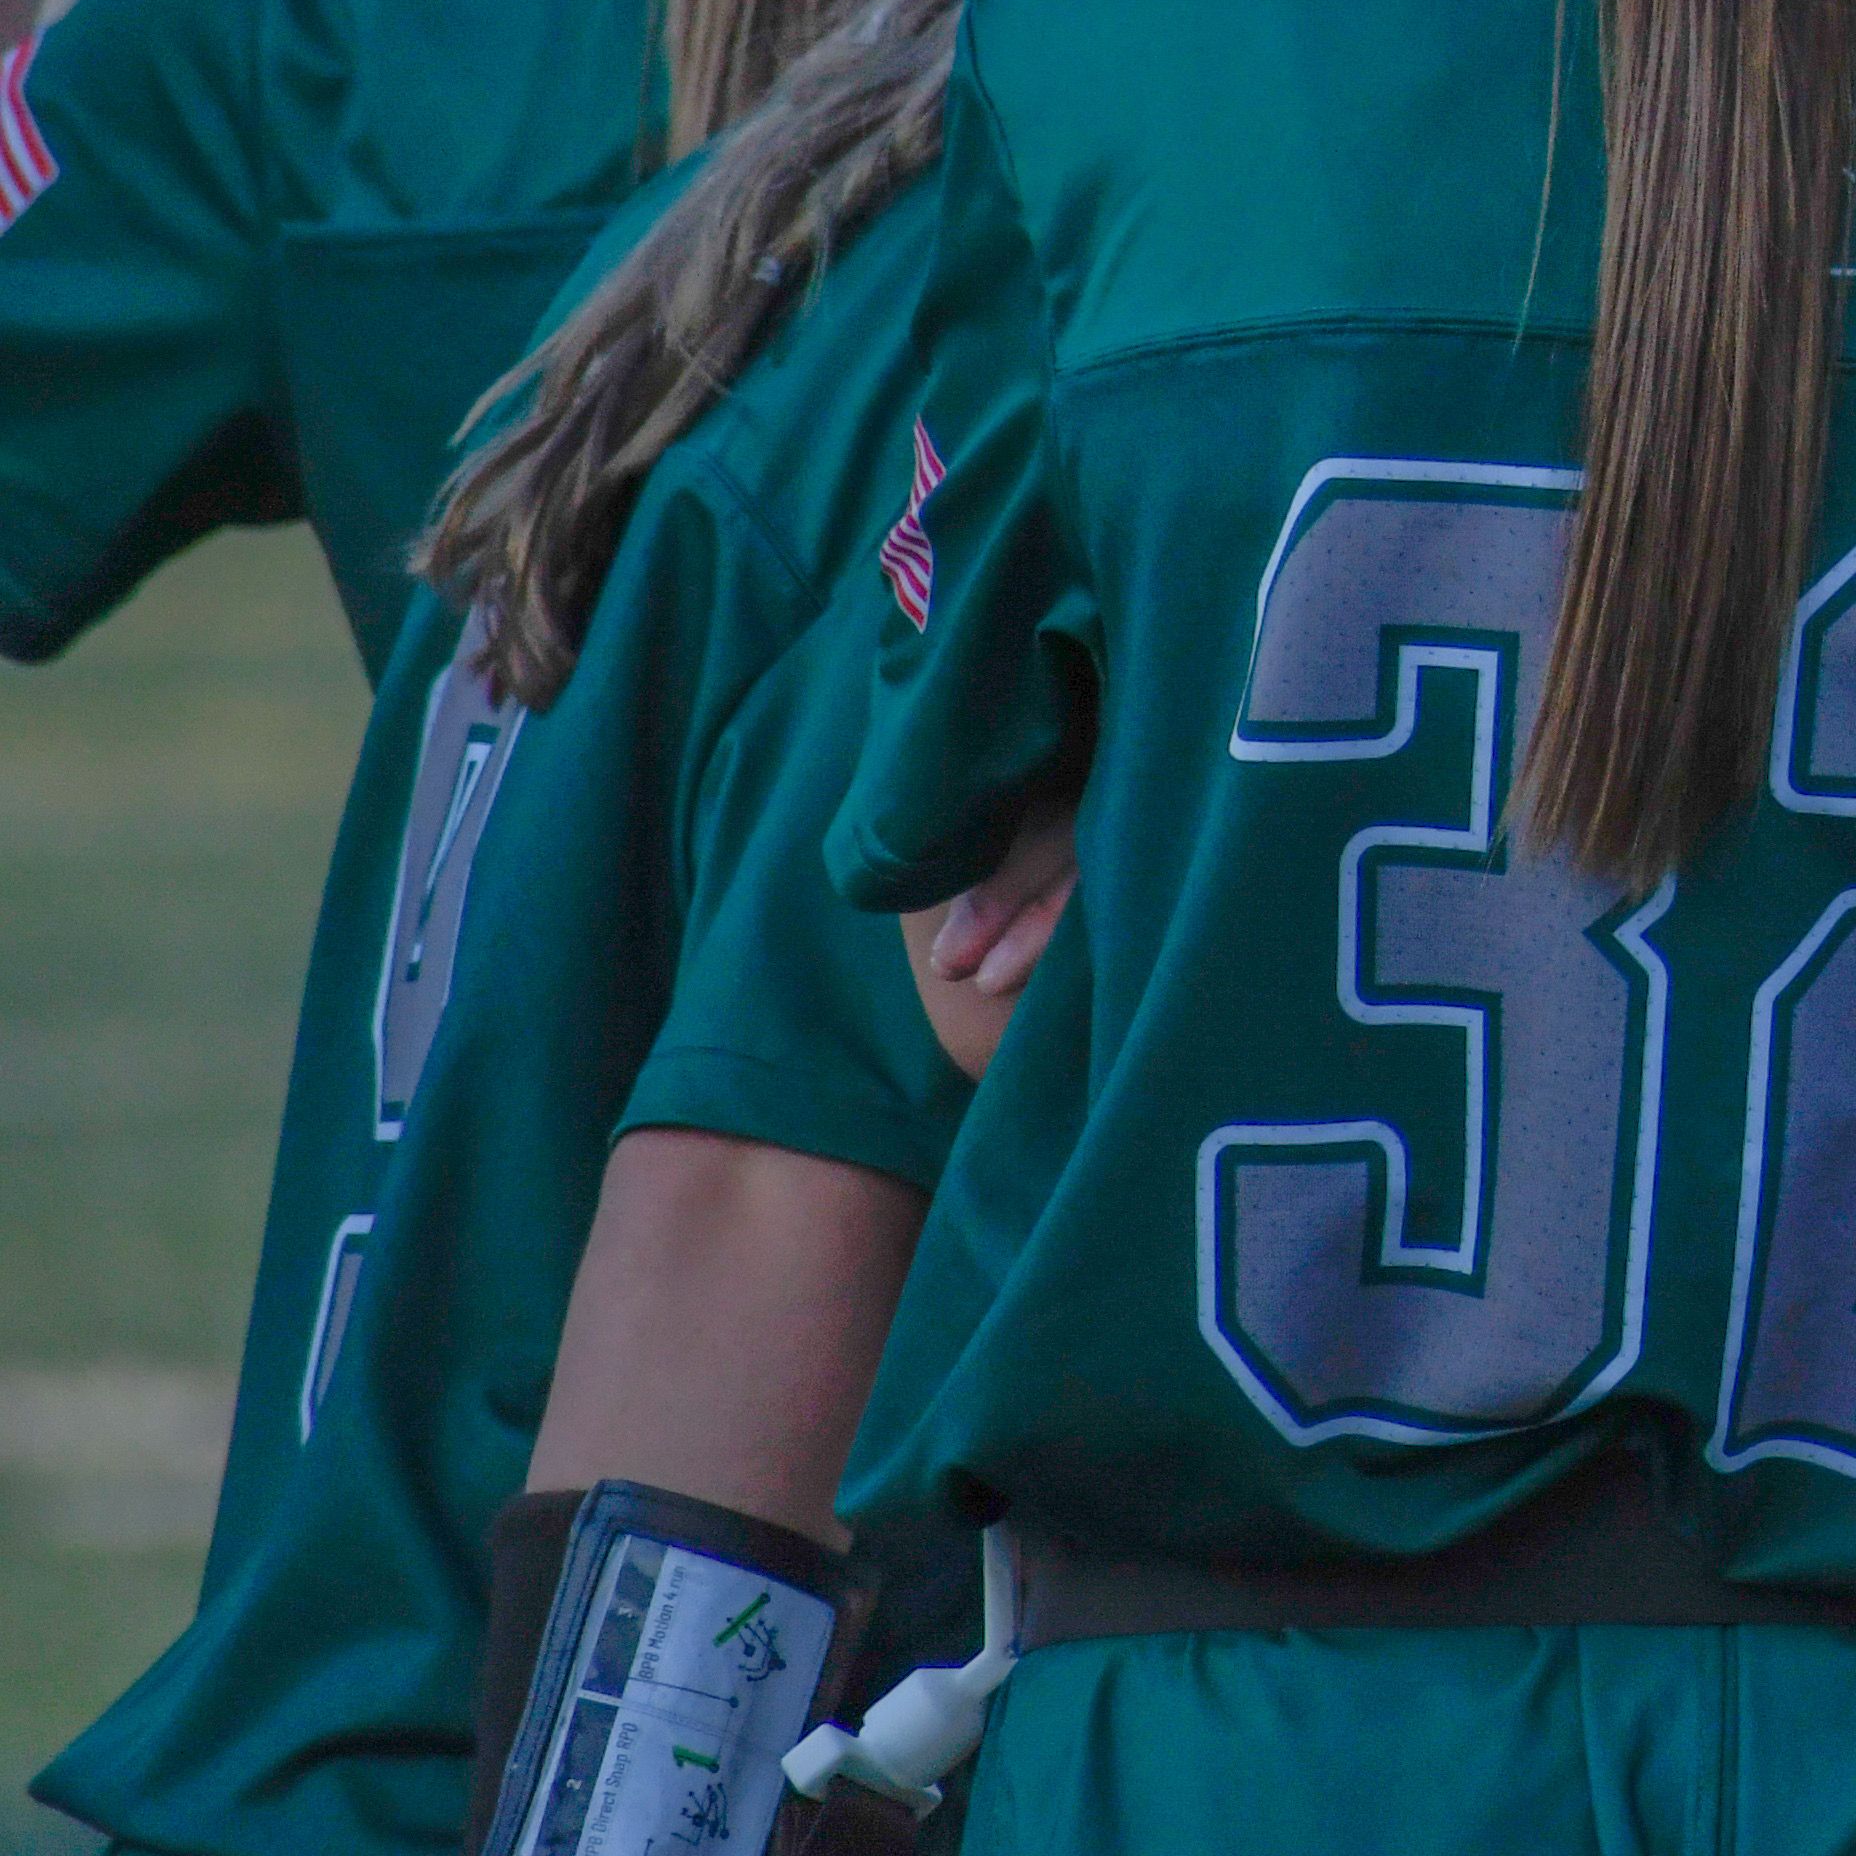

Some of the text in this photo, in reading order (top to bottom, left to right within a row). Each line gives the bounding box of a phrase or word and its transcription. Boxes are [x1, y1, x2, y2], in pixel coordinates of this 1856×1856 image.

[647, 1604, 674, 1650] Motion
[670, 1565, 687, 1590] run
[590, 1790, 617, 1834] Direct
[605, 1754, 632, 1788] Snap
